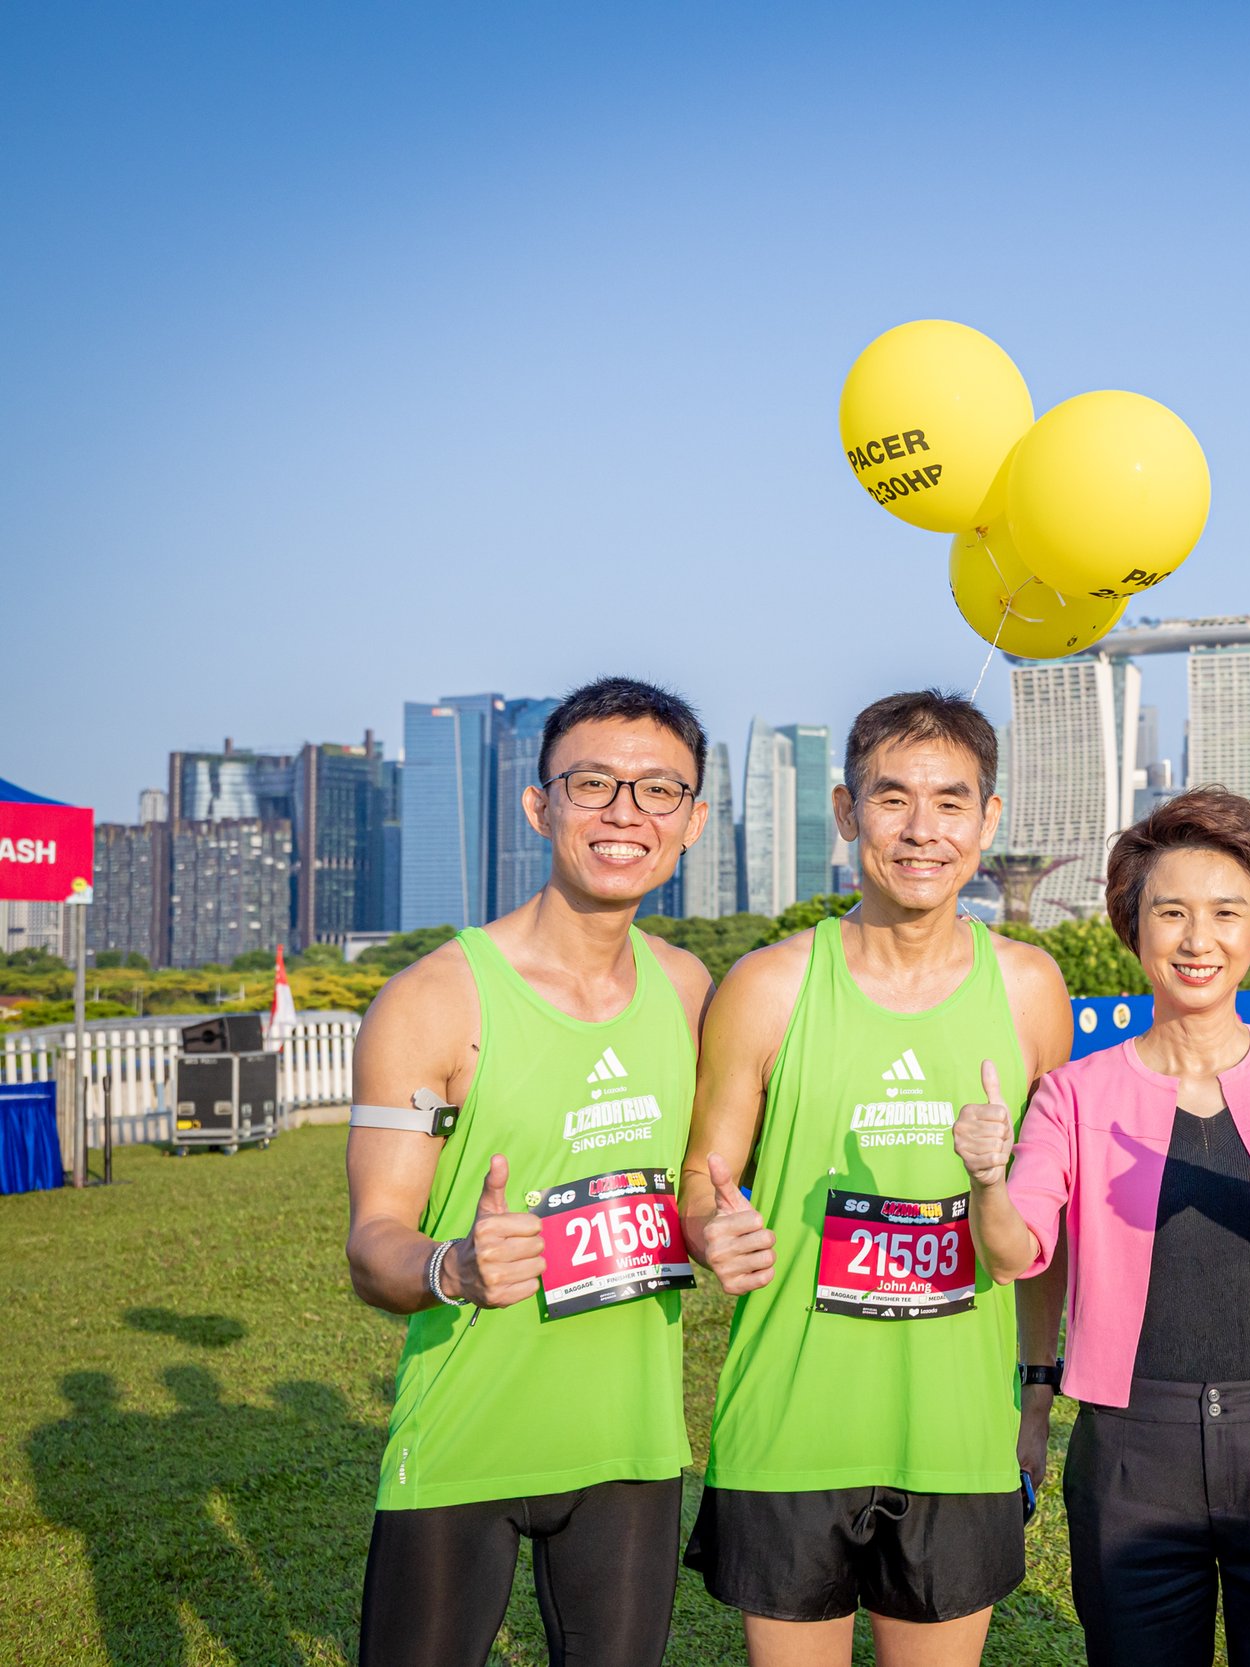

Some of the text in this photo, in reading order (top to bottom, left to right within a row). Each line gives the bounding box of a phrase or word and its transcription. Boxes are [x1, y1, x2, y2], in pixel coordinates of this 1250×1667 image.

[847, 429, 930, 474] PACER
[1121, 568, 1173, 586] PAC
[0, 837, 57, 865] ASH
[563, 1094, 662, 1140] LAZADA RUN
[850, 1101, 956, 1130] LAZADA RUN
[571, 1126, 653, 1154] SINGAPORE
[860, 1132, 945, 1148] SINGAPORE
[548, 1189, 576, 1208] SG
[844, 1199, 870, 1213] SG
[565, 1202, 671, 1267] 21585
[615, 1252, 654, 1269] Windy
[847, 1228, 959, 1279] 21593
[606, 1272, 636, 1284] FINISHER
[876, 1280, 932, 1293] John Ang
[564, 1281, 594, 1295] BAGGAGE
[830, 1291, 858, 1301] BAGGAGE
